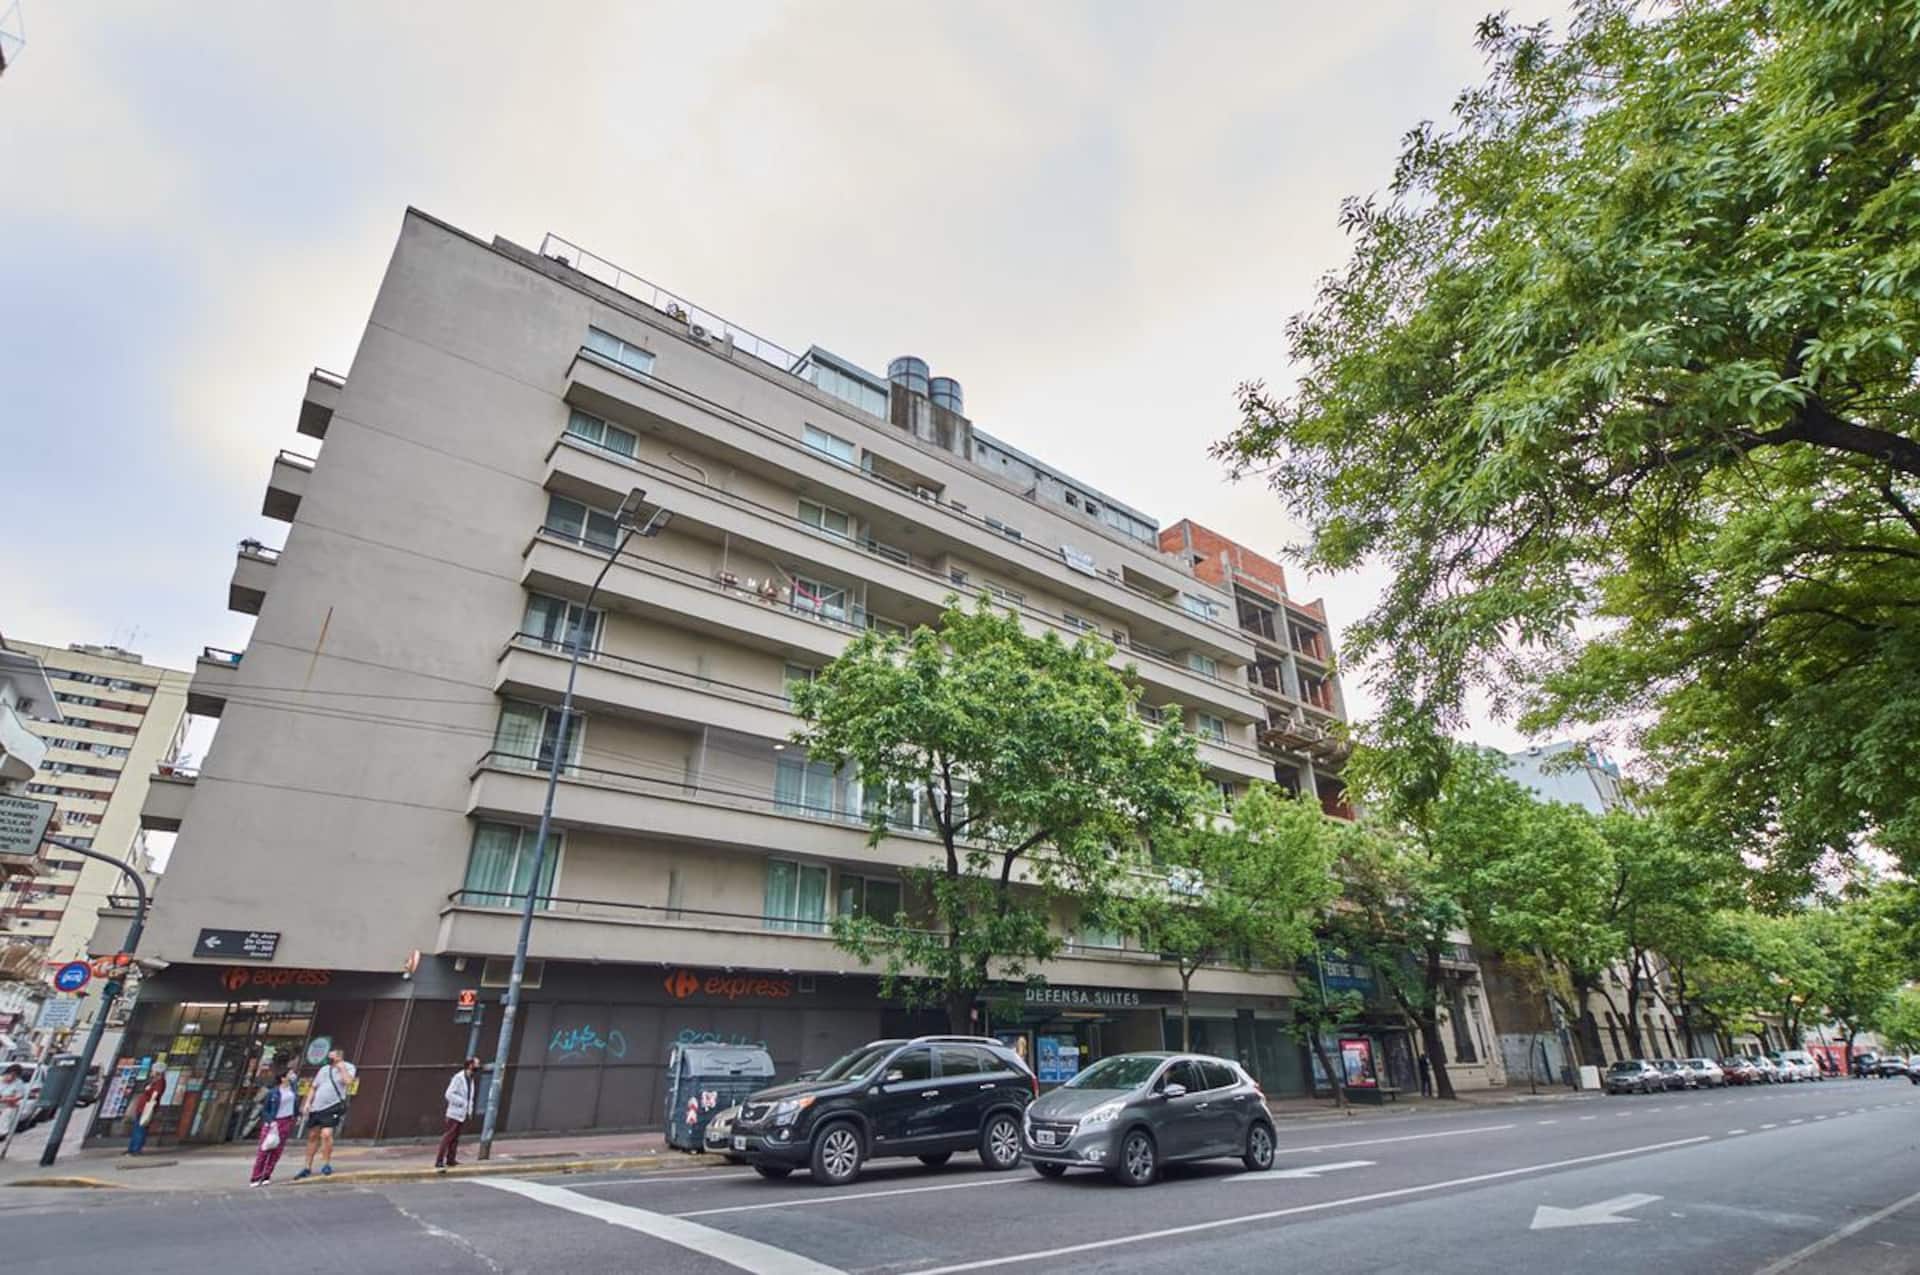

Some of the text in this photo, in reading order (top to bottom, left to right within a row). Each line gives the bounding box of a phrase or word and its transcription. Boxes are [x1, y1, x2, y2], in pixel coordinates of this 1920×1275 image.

[253, 969, 331, 988] express
[704, 978, 793, 1000] express
[1025, 987, 1140, 1006] DEFENSA SUITES
